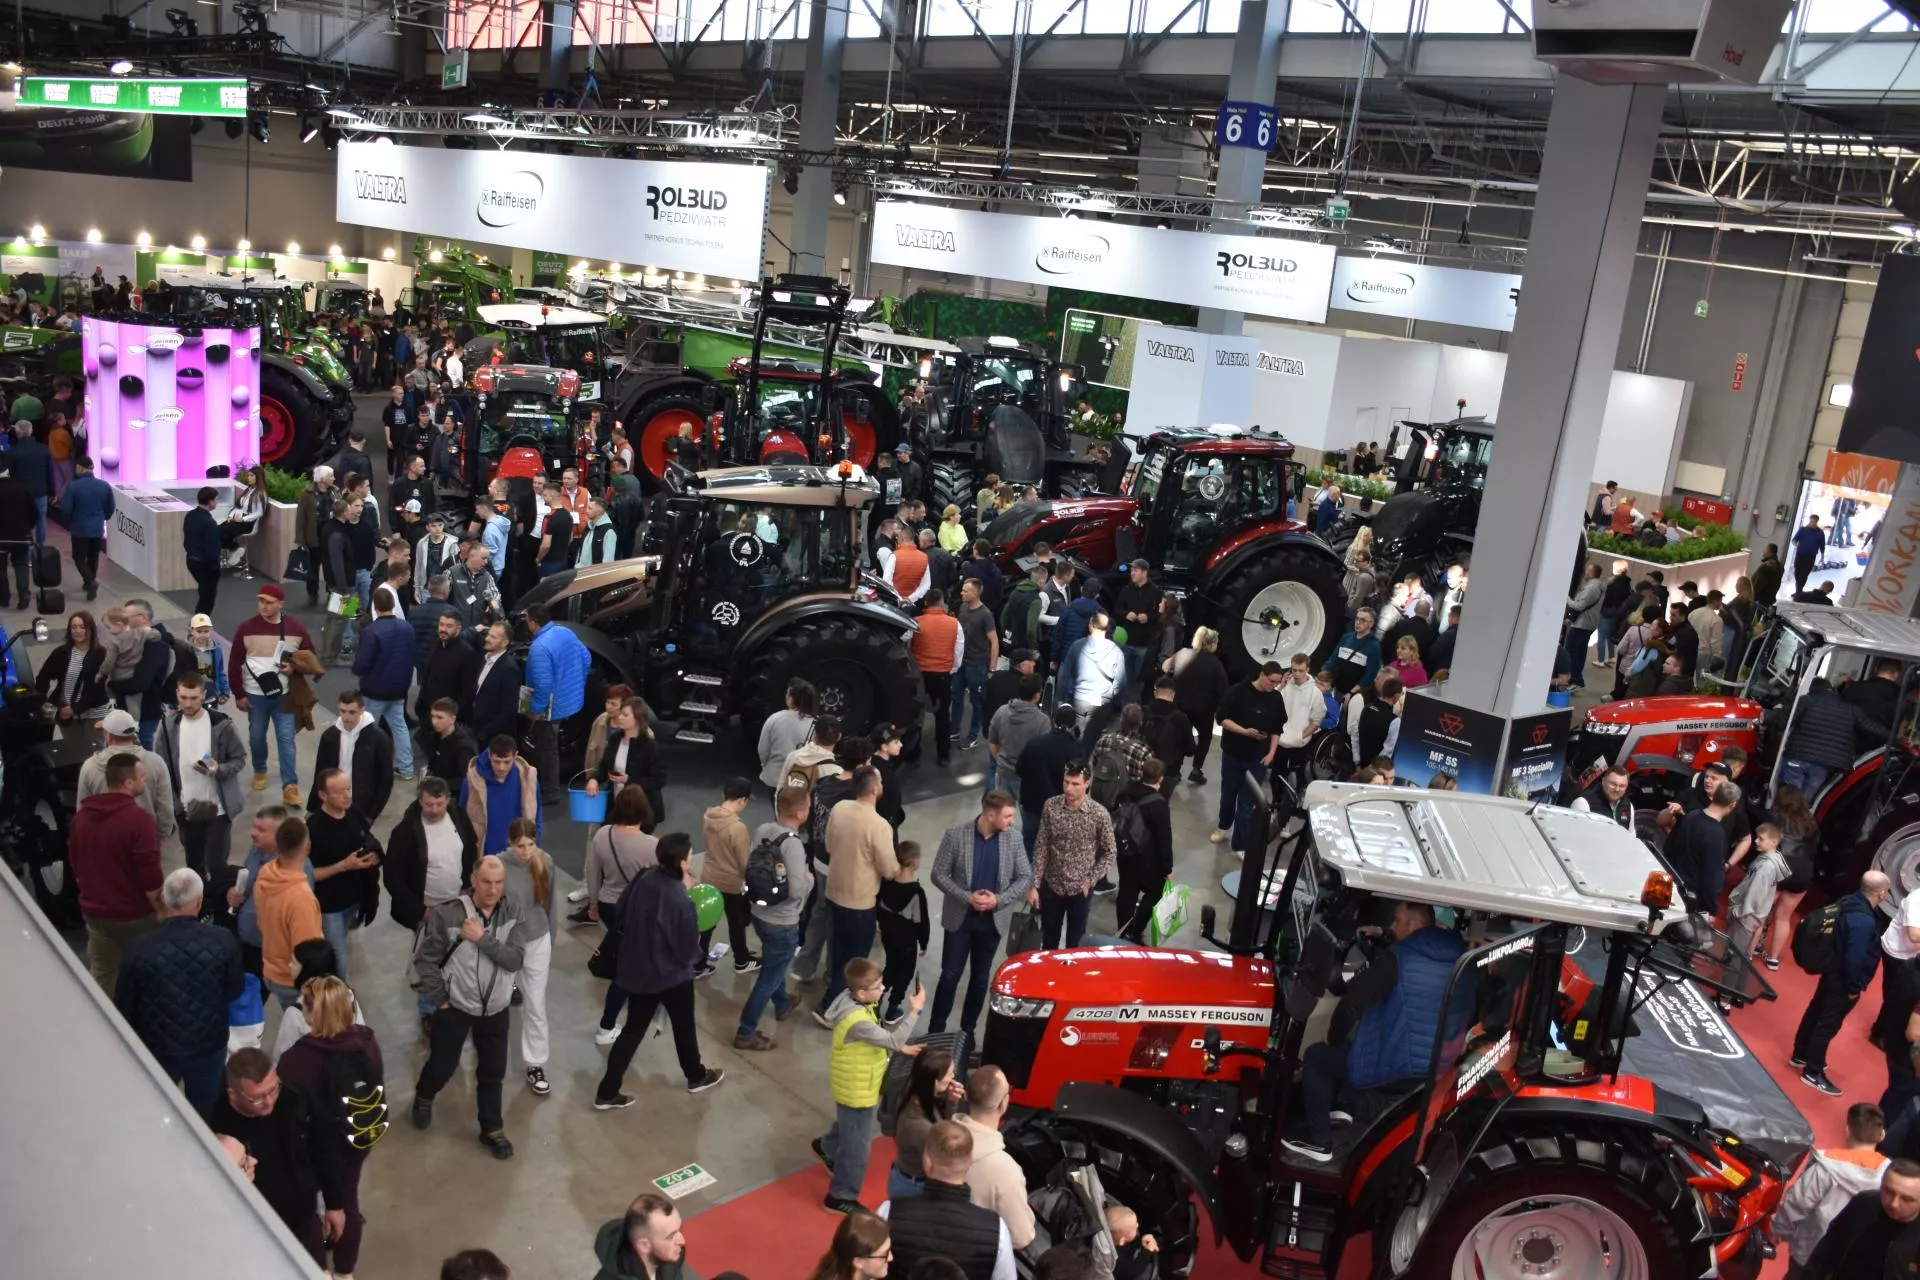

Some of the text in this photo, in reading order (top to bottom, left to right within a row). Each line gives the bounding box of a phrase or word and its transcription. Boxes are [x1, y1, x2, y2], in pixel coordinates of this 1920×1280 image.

[38, 114, 106, 129] DEUTZ-FAHR
[1226, 115, 1243, 142] 6
[1258, 119, 1270, 146] 6
[355, 170, 407, 204] VALTRA
[490, 190, 537, 211] Raiffeisen
[646, 186, 727, 220] ROLBUD
[896, 224, 955, 252] VALTRA
[1051, 246, 1102, 263] Raiffeisen
[1217, 251, 1297, 276] ROLBUD
[1361, 280, 1408, 296] Raiffeisen
[1147, 340, 1195, 362] VALTRA
[1216, 350, 1249, 366] VALTRA
[116, 509, 145, 547] VALTRA
[1424, 729, 1472, 747] MASSEY FERGUSON
[1429, 750, 1458, 767] MF 5S
[1511, 767, 1521, 777] MF
[1522, 765, 1527, 775] 3
[1075, 1008, 1264, 1022] 4708 M MASSEY FERGUSON
[1458, 1030, 1511, 1089] FINANSOWANIE
[1457, 1052, 1499, 1101] FABRYCZNE
[665, 1169, 694, 1185] 6-02
